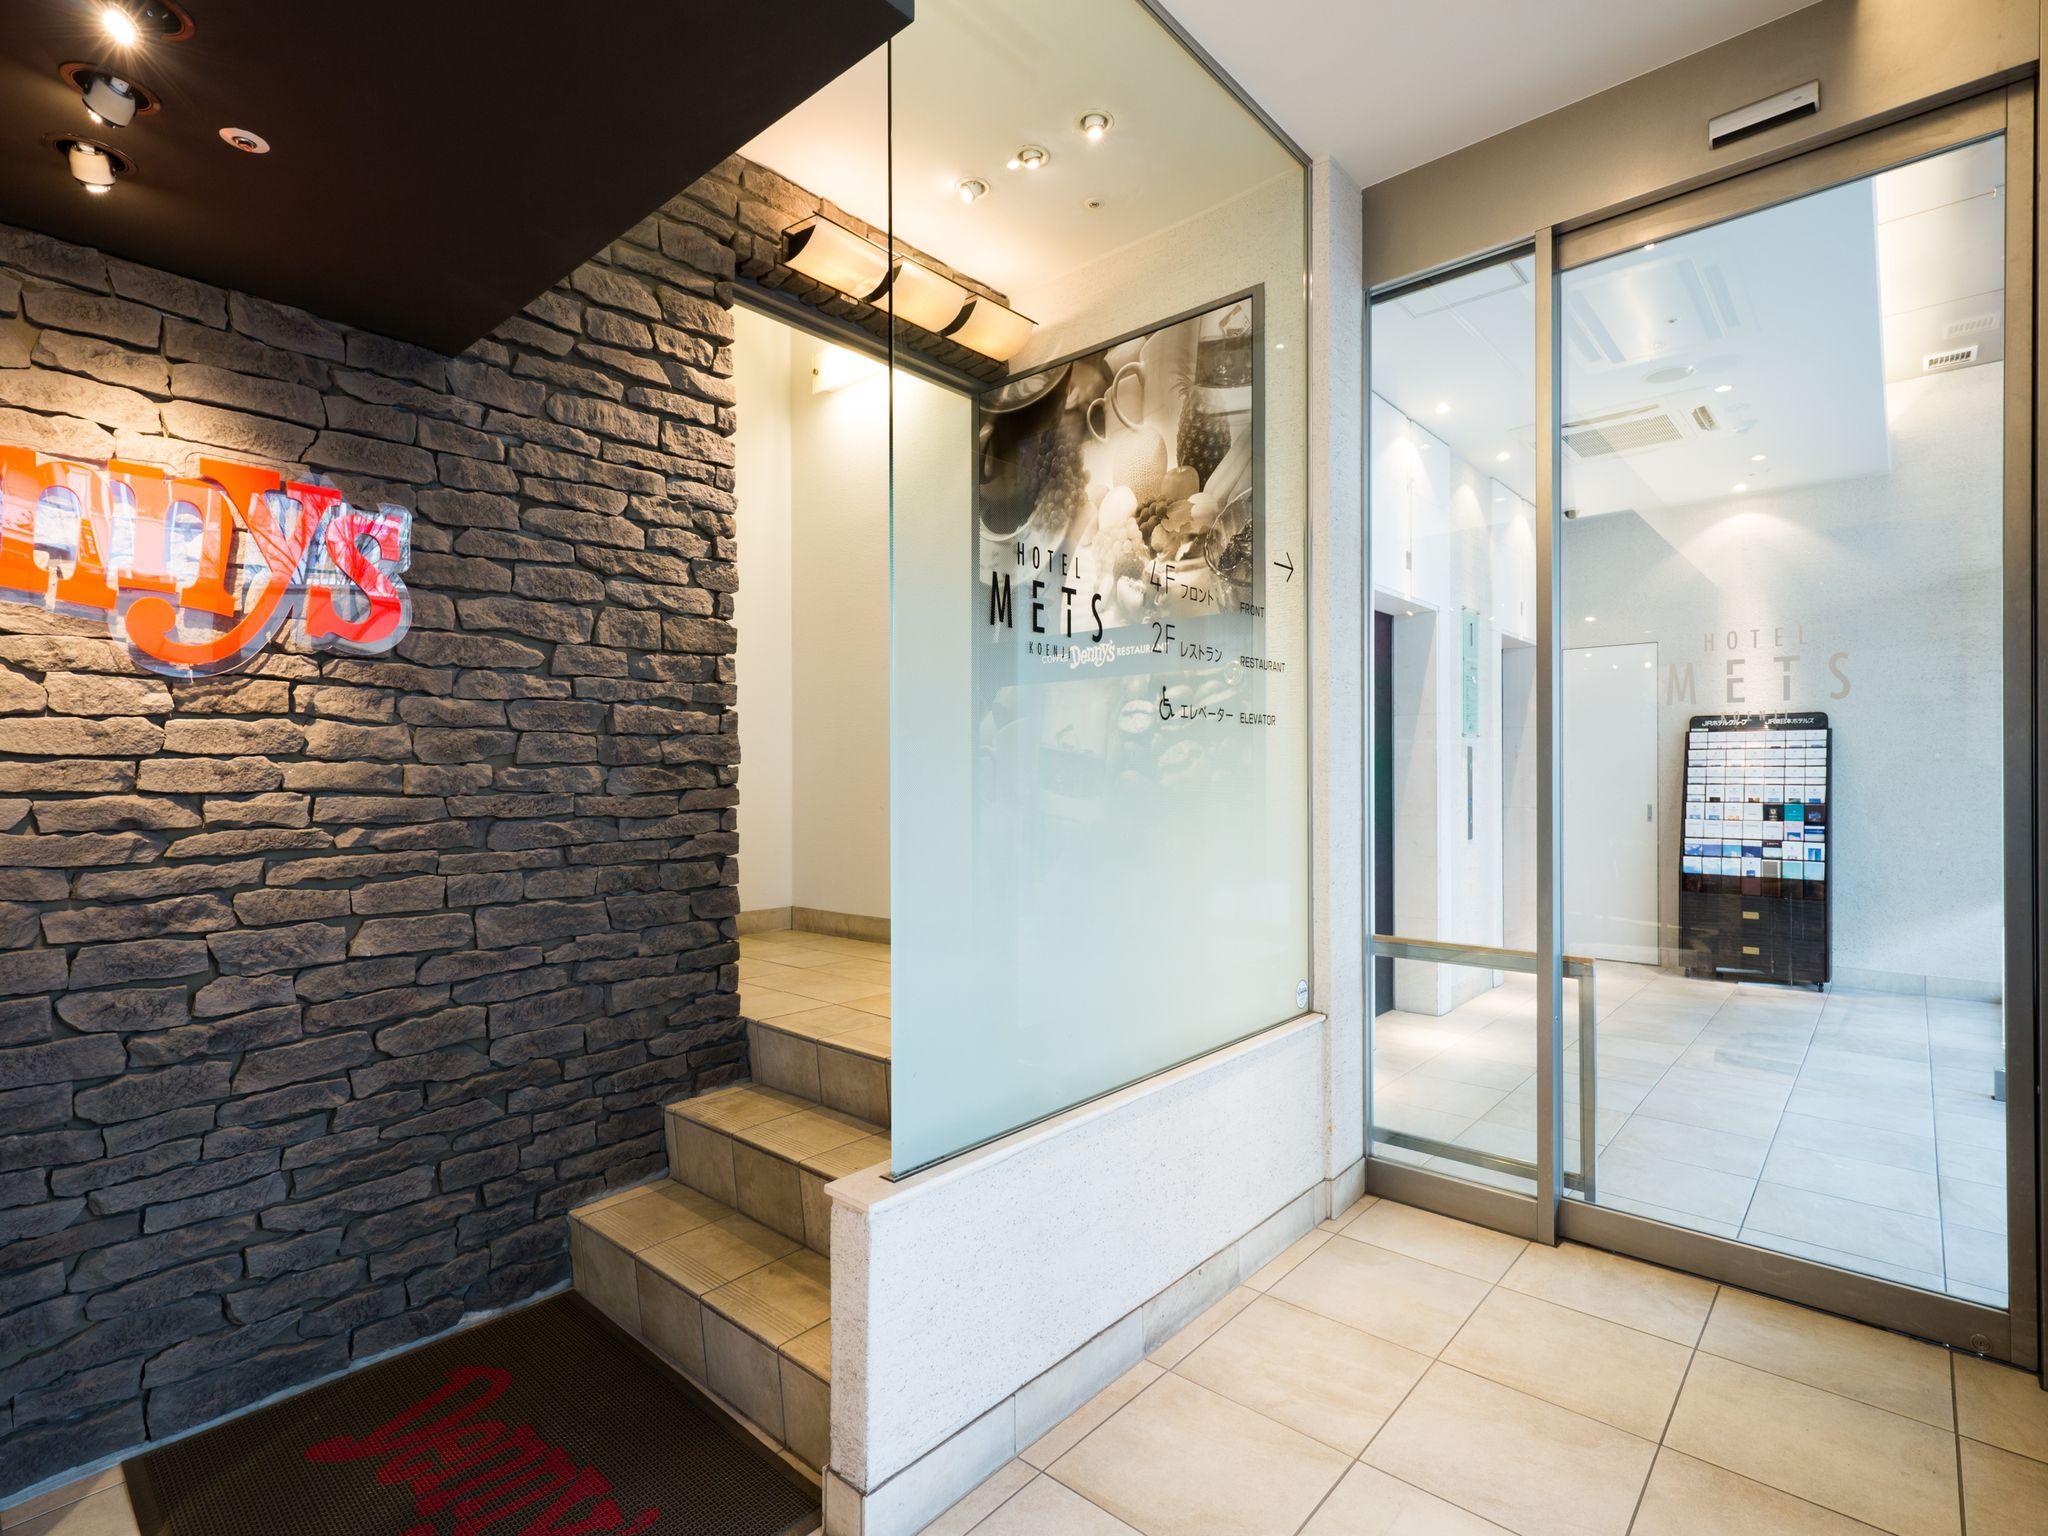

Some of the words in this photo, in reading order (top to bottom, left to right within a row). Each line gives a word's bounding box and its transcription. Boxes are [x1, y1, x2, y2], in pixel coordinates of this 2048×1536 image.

[1017, 542, 1081, 579] HOTEL
[990, 571, 1104, 642] METS
[1150, 561, 1175, 594] 4F
[1181, 584, 1214, 606] フロント
[1240, 602, 1265, 618] FRONT
[1029, 641, 1071, 659] KOENJI
[1069, 640, 1116, 669] Denny's
[1152, 622, 1175, 654] 2F
[1181, 641, 1222, 662] レストラン
[1240, 656, 1285, 672] RESTAURANT
[1704, 626, 1808, 652] HOTEL
[1666, 652, 1851, 705] METS
[1181, 704, 1233, 722] エレベーター
[1240, 712, 1276, 726] ELEVATOR
